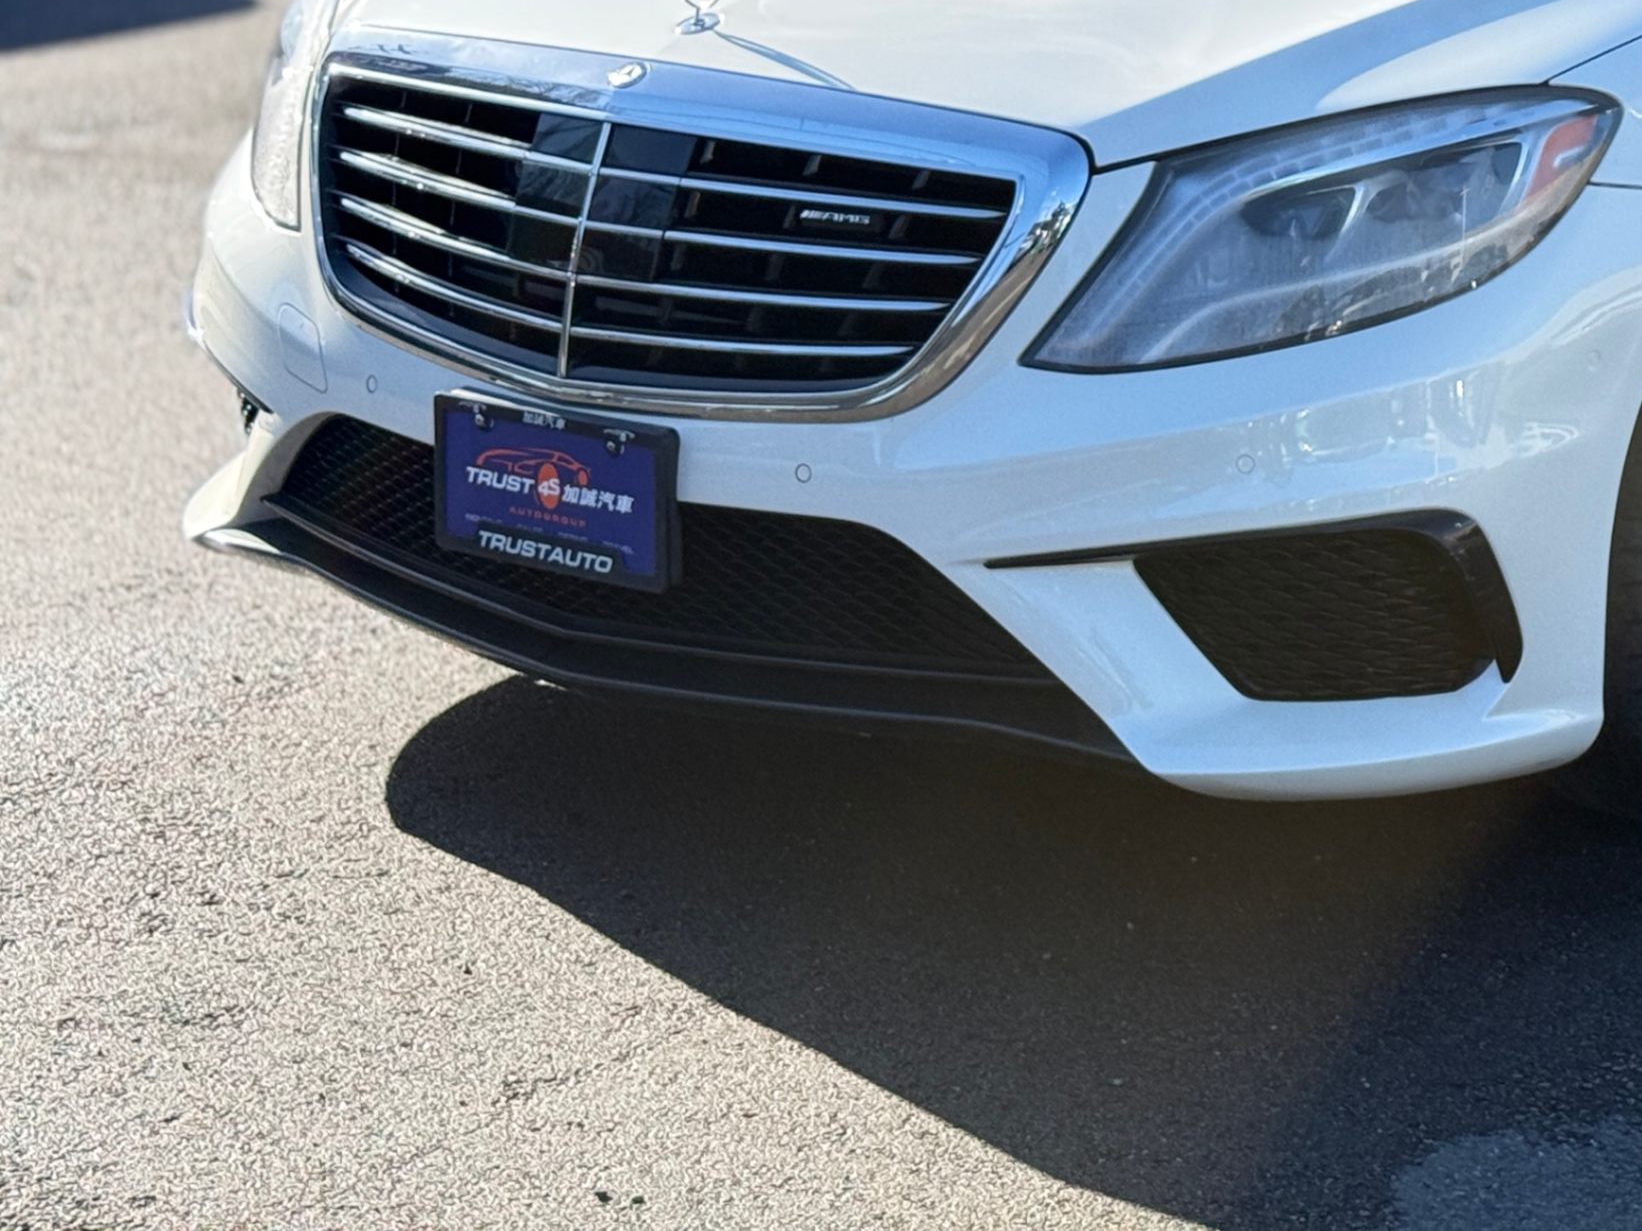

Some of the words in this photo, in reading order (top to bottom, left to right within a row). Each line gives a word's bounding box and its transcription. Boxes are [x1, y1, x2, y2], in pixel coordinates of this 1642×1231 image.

[466, 466, 535, 494] TRUST
[538, 478, 560, 496] 4S
[509, 506, 587, 527] AUTOGROUP
[478, 530, 614, 573] TRUSTAUTO
